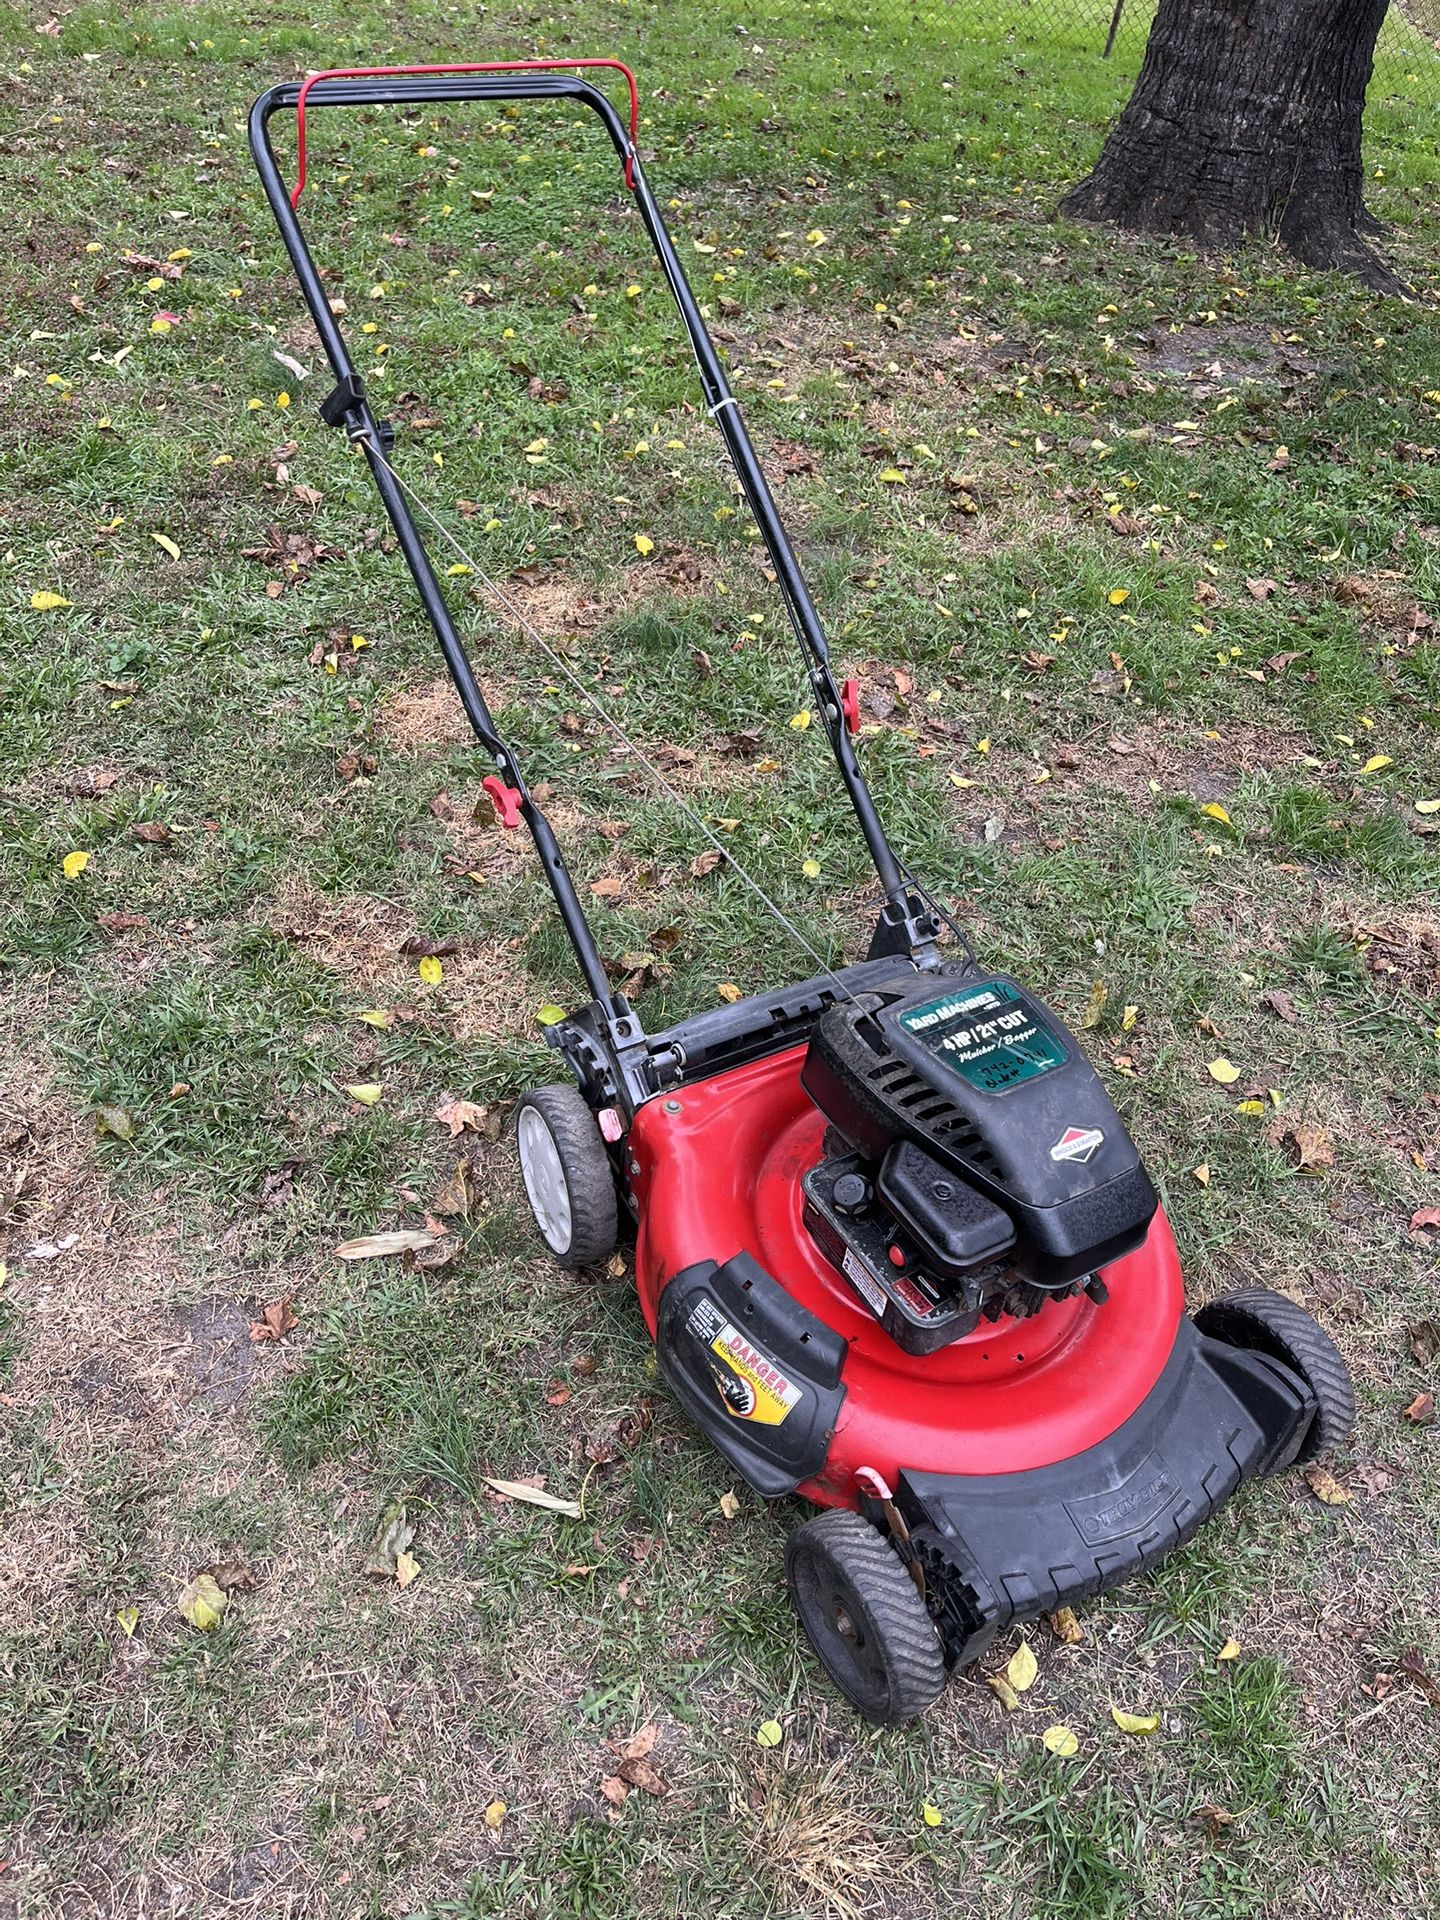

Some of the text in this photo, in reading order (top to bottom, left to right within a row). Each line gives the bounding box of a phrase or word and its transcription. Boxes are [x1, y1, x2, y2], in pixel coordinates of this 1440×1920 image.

[906, 992, 997, 1031] YARD MACHINES
[943, 1037, 956, 1051] 4
[953, 1031, 972, 1048] HP
[997, 1009, 1029, 1030] CUT
[956, 1042, 997, 1063] Mulcher
[1003, 1027, 1038, 1046] Bagger
[729, 1335, 789, 1395] DANGER
[731, 1354, 749, 1374] HANDS
[747, 1370, 758, 1383] and
[756, 1379, 773, 1395] FEET
[770, 1391, 789, 1410] AWAY
